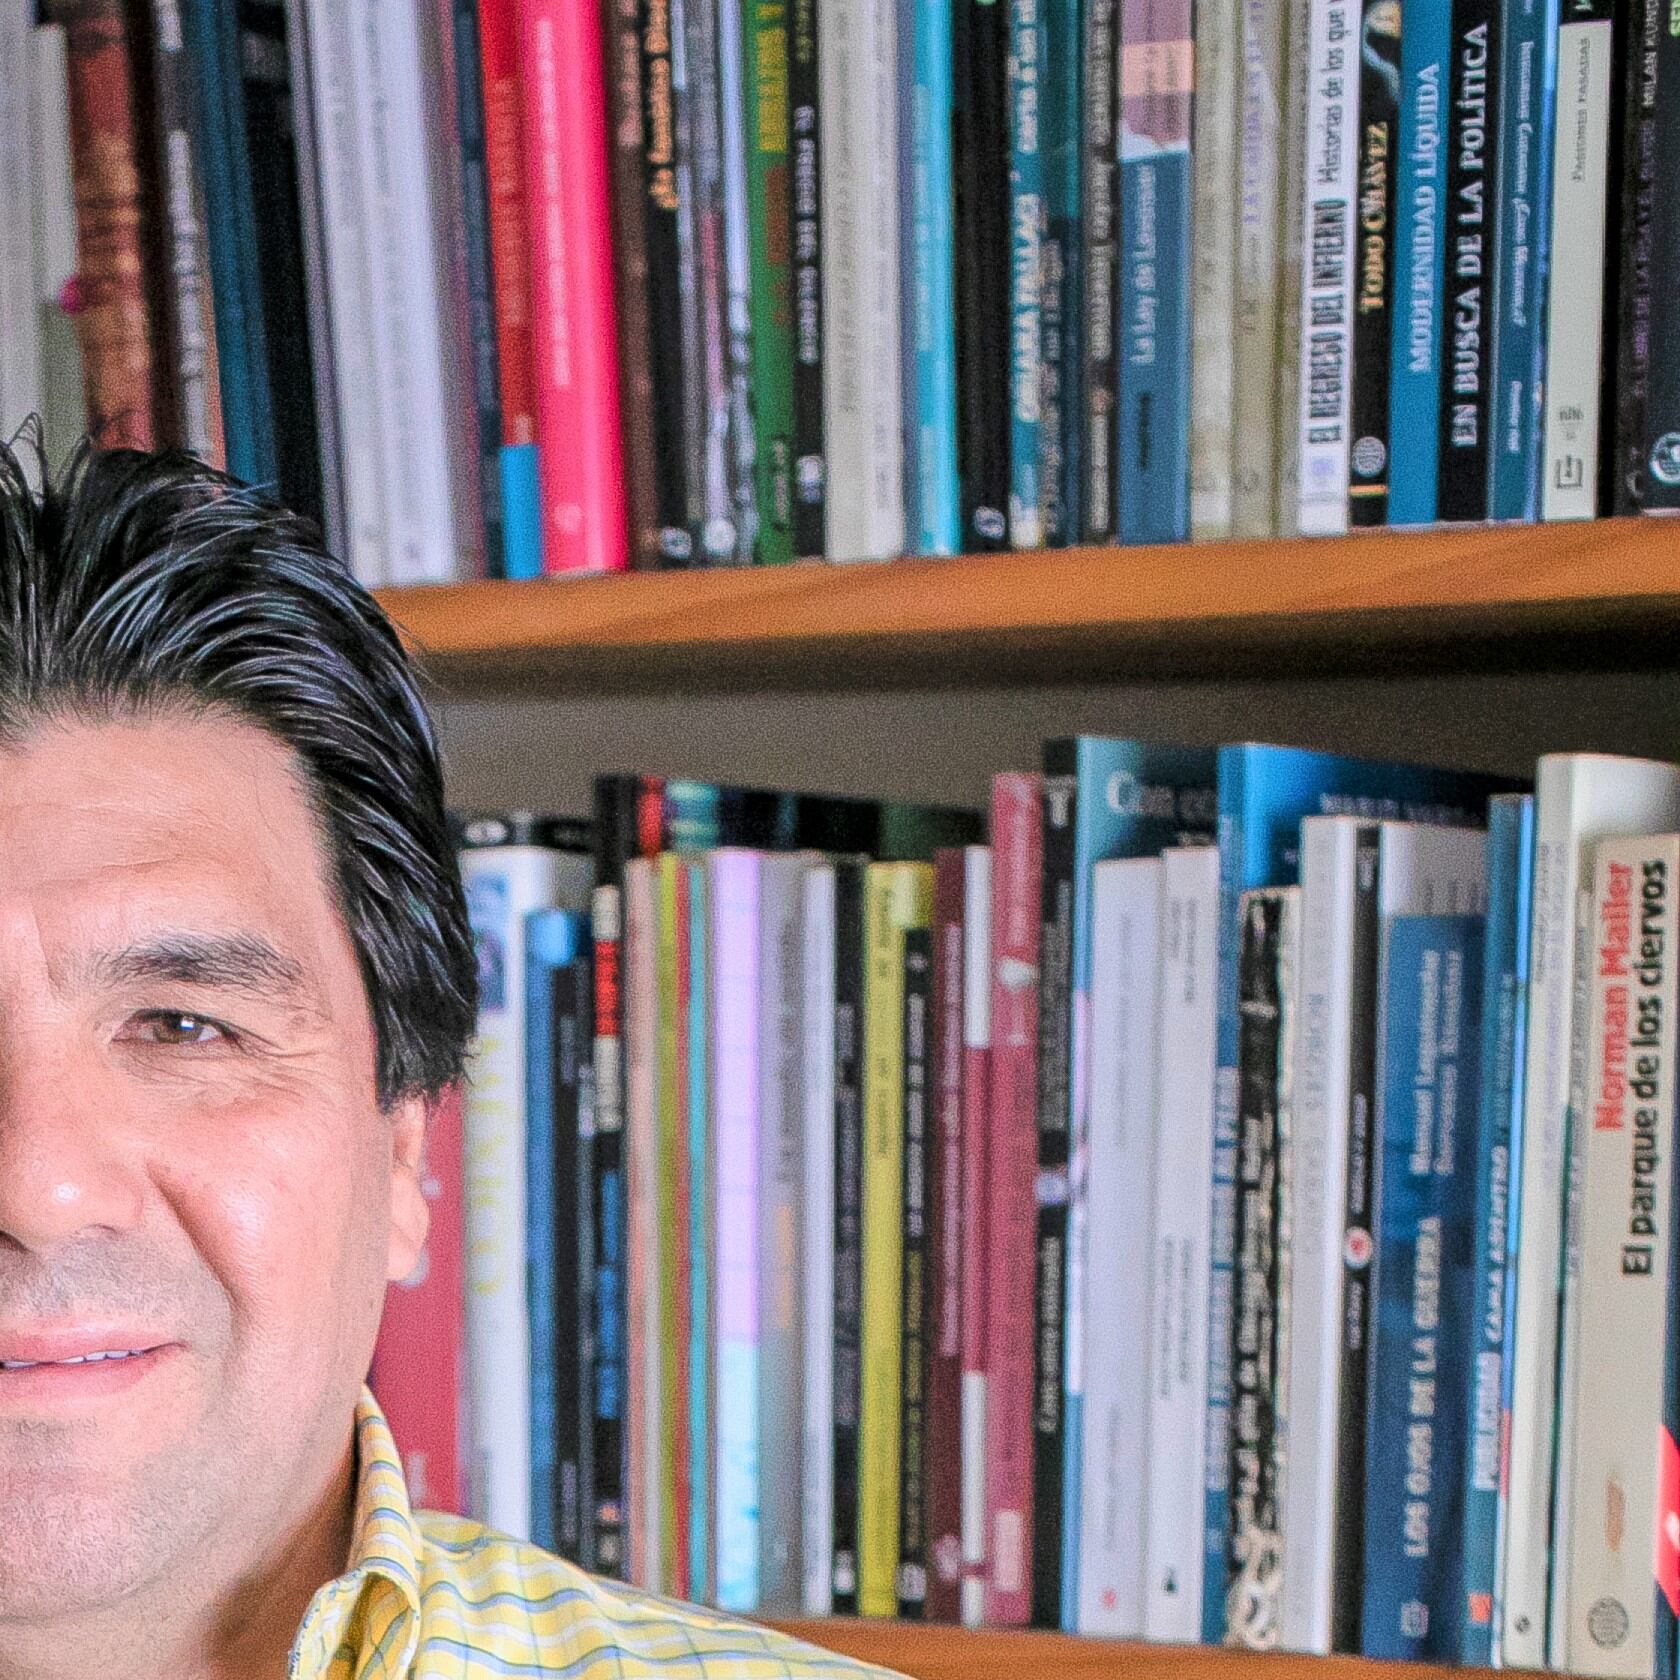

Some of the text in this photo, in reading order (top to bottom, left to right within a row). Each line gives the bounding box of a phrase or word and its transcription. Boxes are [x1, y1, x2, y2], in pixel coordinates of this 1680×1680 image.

[1316, 9, 1350, 184] Historias de los que
[1641, 51, 1658, 107] MILAN
[1361, 236, 1385, 312] TODO
[1409, 62, 1442, 373] MODERNIDAD LÍQUIDA
[1451, 22, 1489, 447] EN BUSCA DE LA POLÍTICA
[1308, 197, 1347, 445] EL REGRESO DEL INFIERNO
[1594, 861, 1632, 1132] Norman Mailer
[1622, 860, 1666, 1277] El parque de los ciervos
[1408, 1376, 1436, 1417] DE
[1411, 1336, 1438, 1373] LA
[1403, 1501, 1431, 1558] LOS
